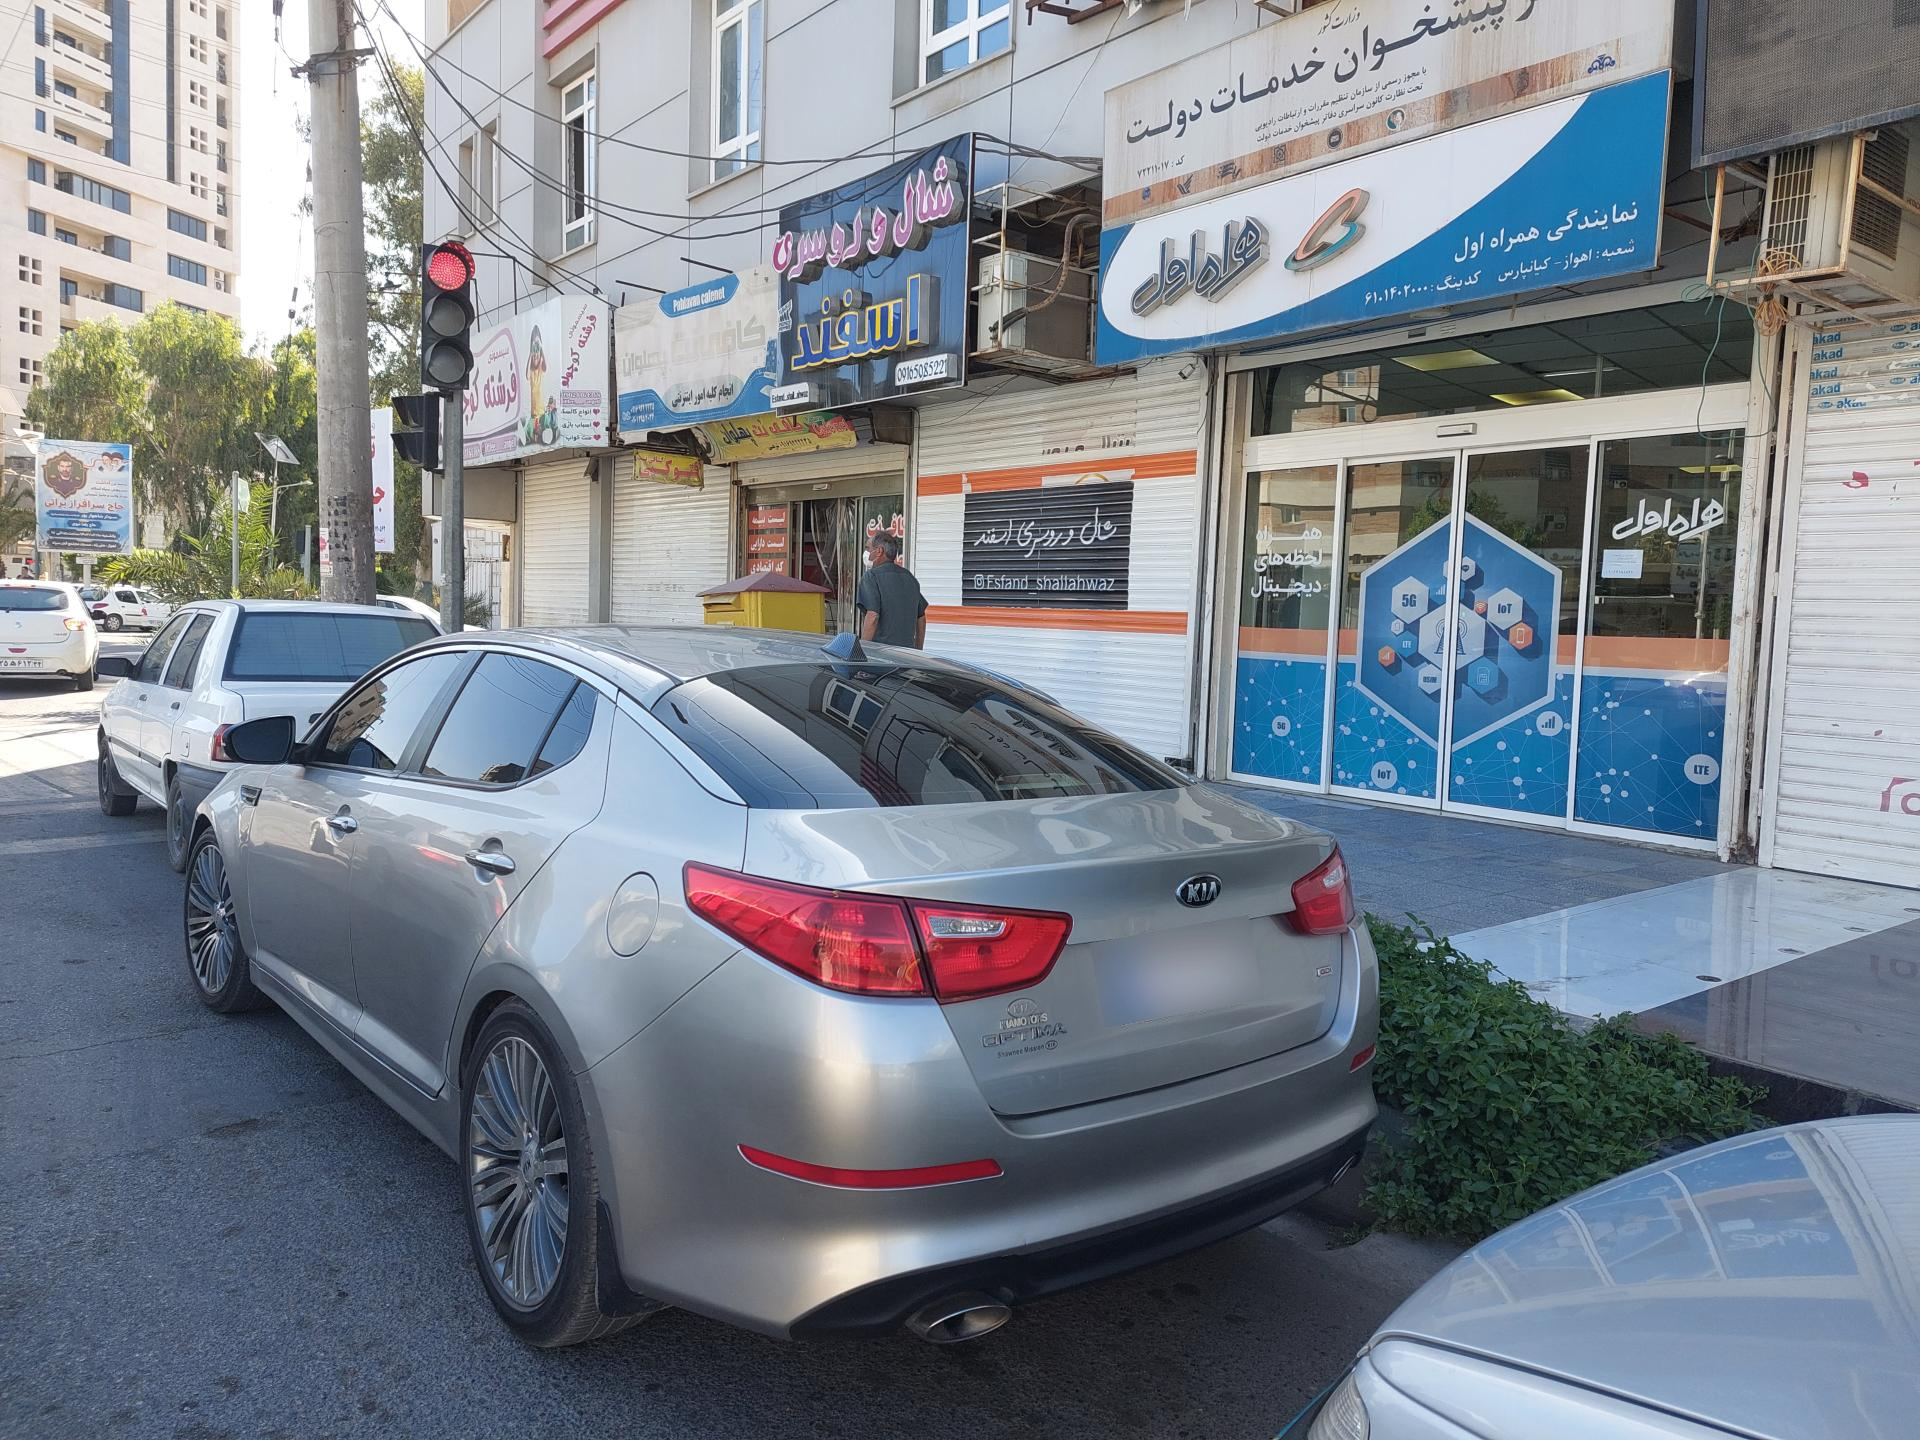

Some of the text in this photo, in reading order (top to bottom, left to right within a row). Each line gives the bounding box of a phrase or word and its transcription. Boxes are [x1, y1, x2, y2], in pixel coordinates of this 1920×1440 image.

[1332, 6, 1361, 29] وزارت
[1126, 0, 1507, 144] پیشخوان خدمات دولت
[1403, 71, 1420, 83] مجوز
[1381, 78, 1402, 91] رسمی
[1406, 82, 1424, 94] تحت
[1330, 92, 1349, 107] تنظیم
[1350, 85, 1373, 101] سازمان
[1385, 88, 1406, 102] نظارت
[1308, 99, 1330, 112] مقررات
[1365, 94, 1384, 110] کانون
[1321, 109, 1337, 124] دفاتر
[1338, 103, 1365, 119] سراسری
[1256, 132, 1271, 143] دولت
[1272, 126, 1293, 138] خدمات
[771, 154, 955, 283] شال و روسری
[1453, 200, 1639, 264] نمایندگی همراه اول
[1130, 229, 1206, 318] اول
[1497, 255, 1552, 283] کیانپارس
[790, 272, 922, 373] اسفند
[561, 313, 597, 389] فرشته کوچولو
[1813, 347, 1844, 361] akad
[483, 361, 518, 413] فرشته
[706, 385, 718, 403] کلیه
[718, 382, 734, 402] انجام
[1810, 382, 1841, 396] akad
[693, 388, 706, 406] امور
[720, 421, 760, 447] پهلوان
[751, 511, 785, 526] لیست بیمه
[1611, 497, 1725, 542] همراه اول
[972, 506, 1118, 559] شال و روسری اسفند
[1255, 525, 1322, 547] همراه
[750, 536, 785, 551] لیست دارایی
[750, 559, 784, 574] کد اقتصادی
[1250, 575, 1322, 599] دیجیتال
[1401, 593, 1418, 608] 5G
[1402, 640, 1413, 649] LTE
[1277, 720, 1286, 732] 5G
[1694, 764, 1711, 777] LTE
[1186, 881, 1219, 903] KIA
[981, 1022, 1067, 1048] OPTIMA
